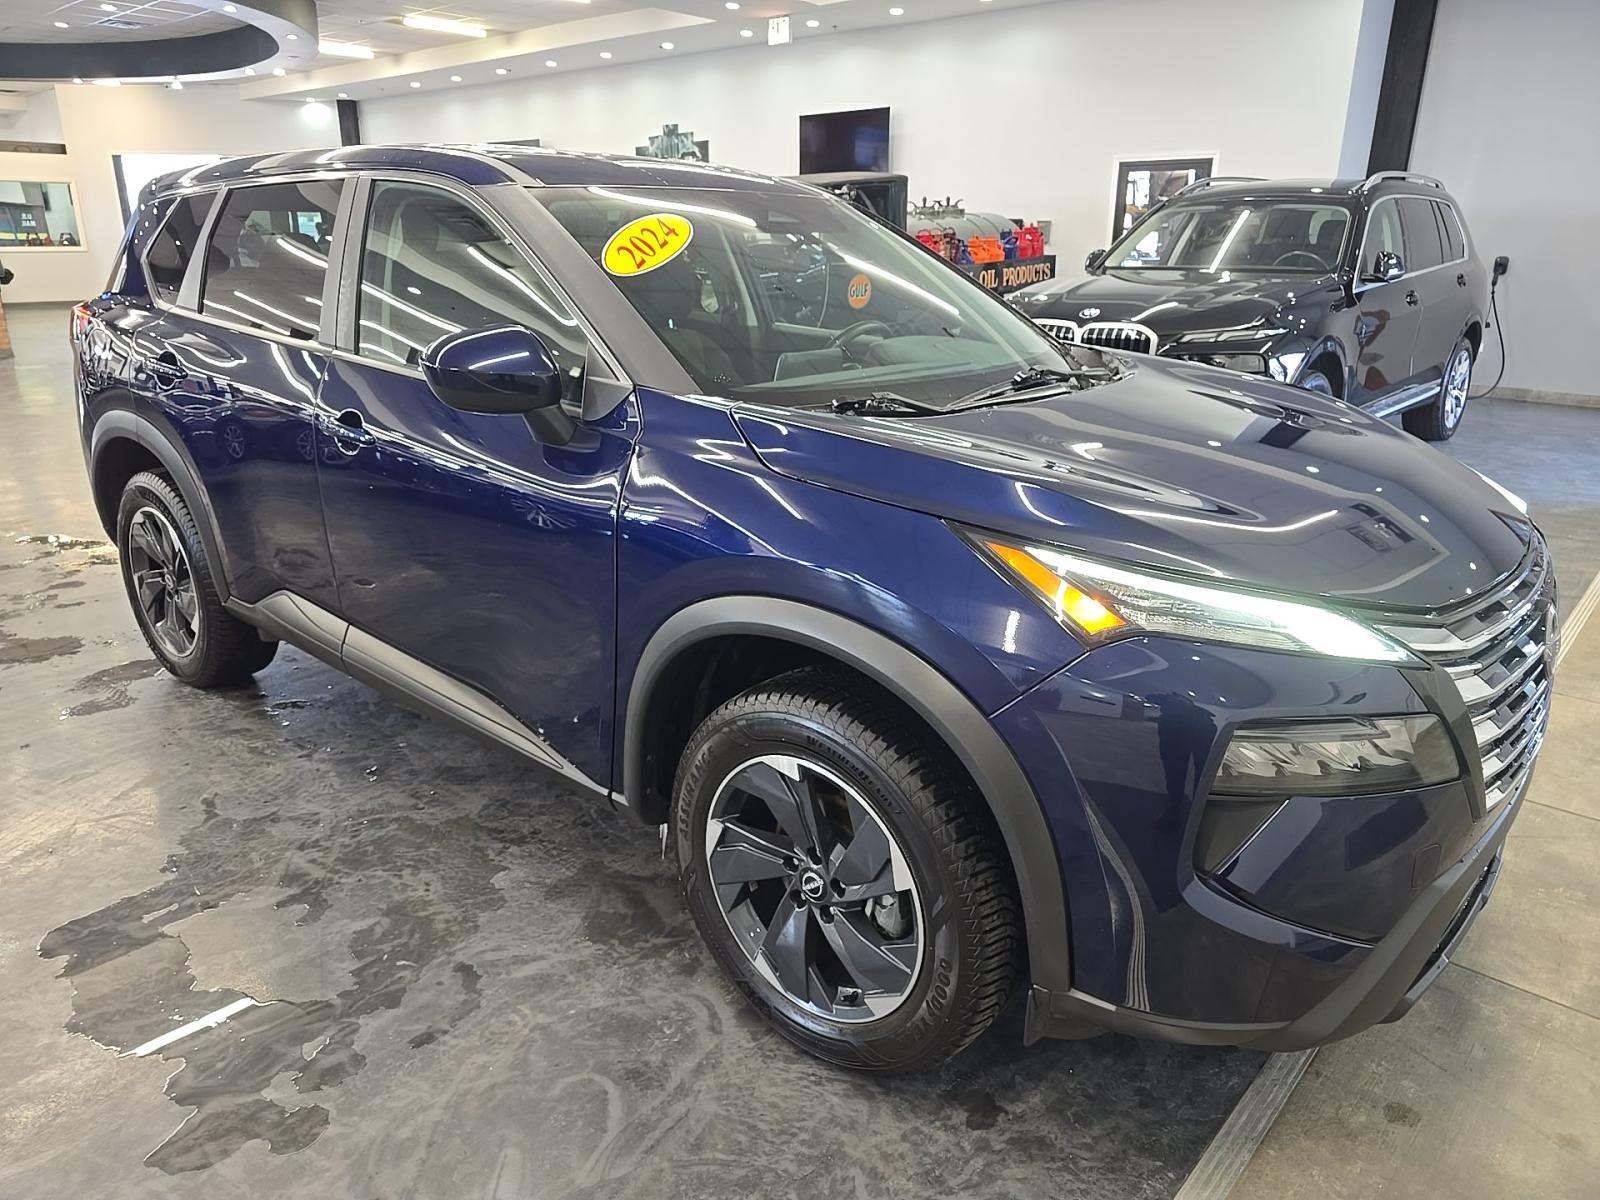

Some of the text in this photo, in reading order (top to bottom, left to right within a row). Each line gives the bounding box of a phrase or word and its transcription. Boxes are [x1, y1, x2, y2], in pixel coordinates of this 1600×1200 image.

[617, 218, 679, 269] 2024
[850, 284, 869, 297] GULF
[979, 263, 1051, 288] OIL PRODUCTS
[680, 745, 713, 842] ASSURANCE
